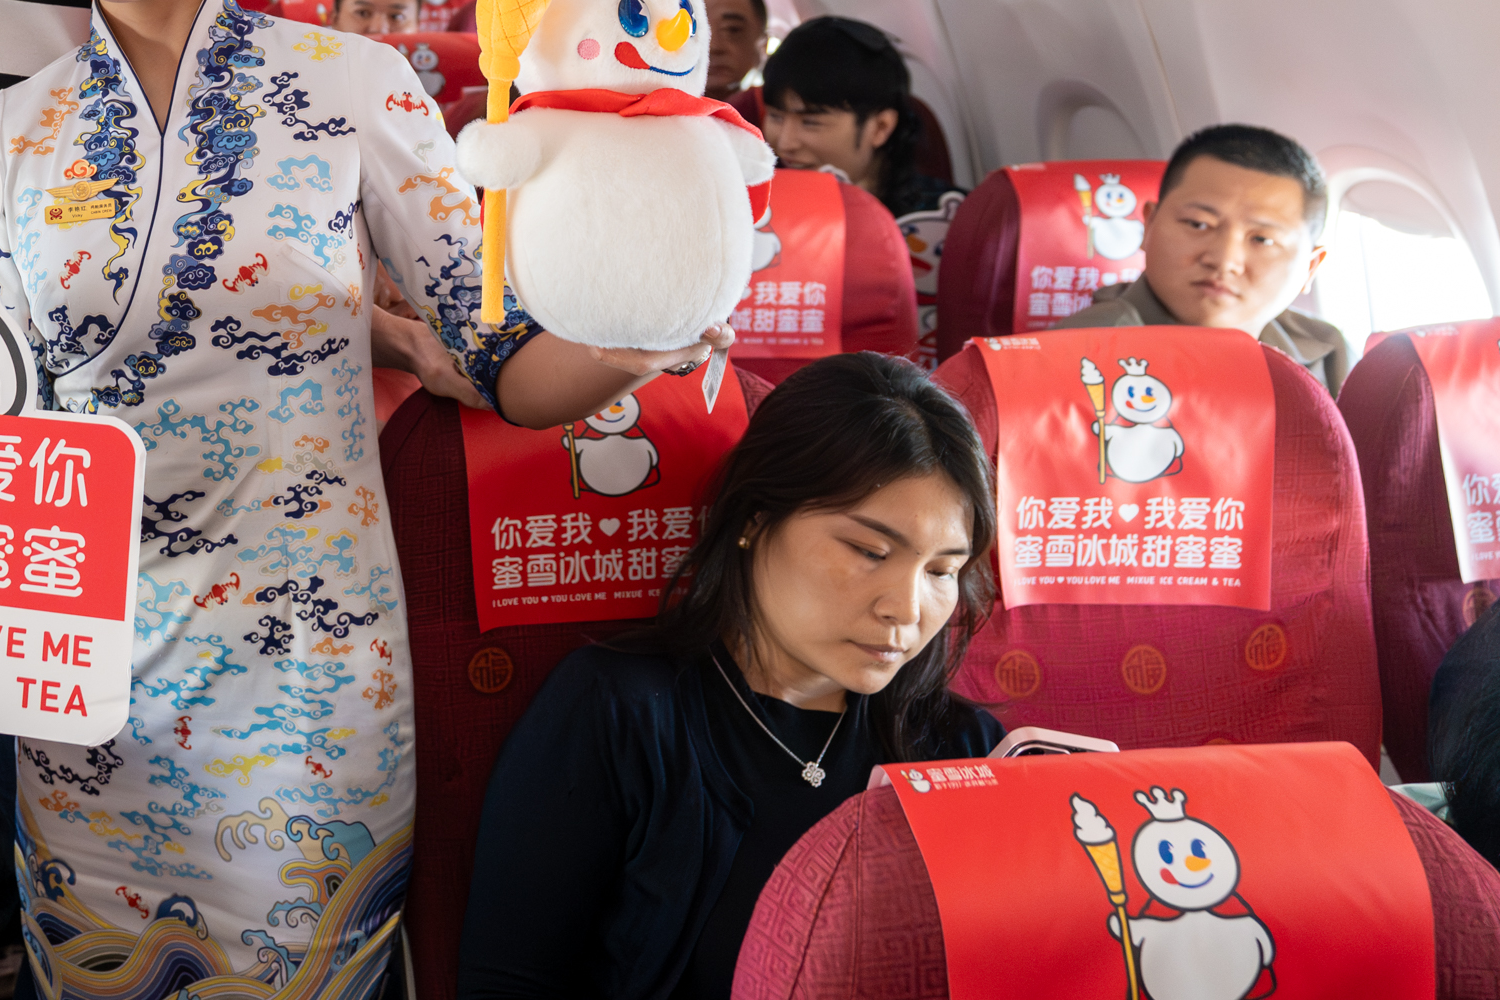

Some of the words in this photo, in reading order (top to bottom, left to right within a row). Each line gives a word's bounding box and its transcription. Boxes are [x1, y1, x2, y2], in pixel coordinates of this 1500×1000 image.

[754, 281, 826, 306] 我爱你
[1031, 266, 1100, 290] 你爱我
[1016, 495, 1114, 530] 你爱我
[1144, 496, 1245, 531] 我爱你
[1467, 511, 1500, 545] 蜜
[491, 511, 593, 552] 你爱我
[1014, 534, 1243, 570] 蜜雪冰城甜蜜蜜
[497, 597, 519, 607] LOVE
[521, 596, 539, 605] YOU
[551, 594, 567, 603] YOU
[569, 593, 592, 602] LOVE
[594, 592, 607, 600] ME
[614, 589, 643, 599] MIXUE
[1018, 576, 1037, 586] LOVE
[1039, 576, 1055, 585] YOU
[1066, 576, 1083, 586] YOU
[1085, 576, 1106, 585] LOVE
[1108, 576, 1120, 585] ME
[1126, 576, 1155, 586] MIXUE
[1160, 576, 1173, 586] ICE
[1177, 576, 1208, 587] CREAM
[1223, 578, 1241, 587] TEA
[41, 630, 94, 668] ME
[16, 676, 89, 718] TEA
